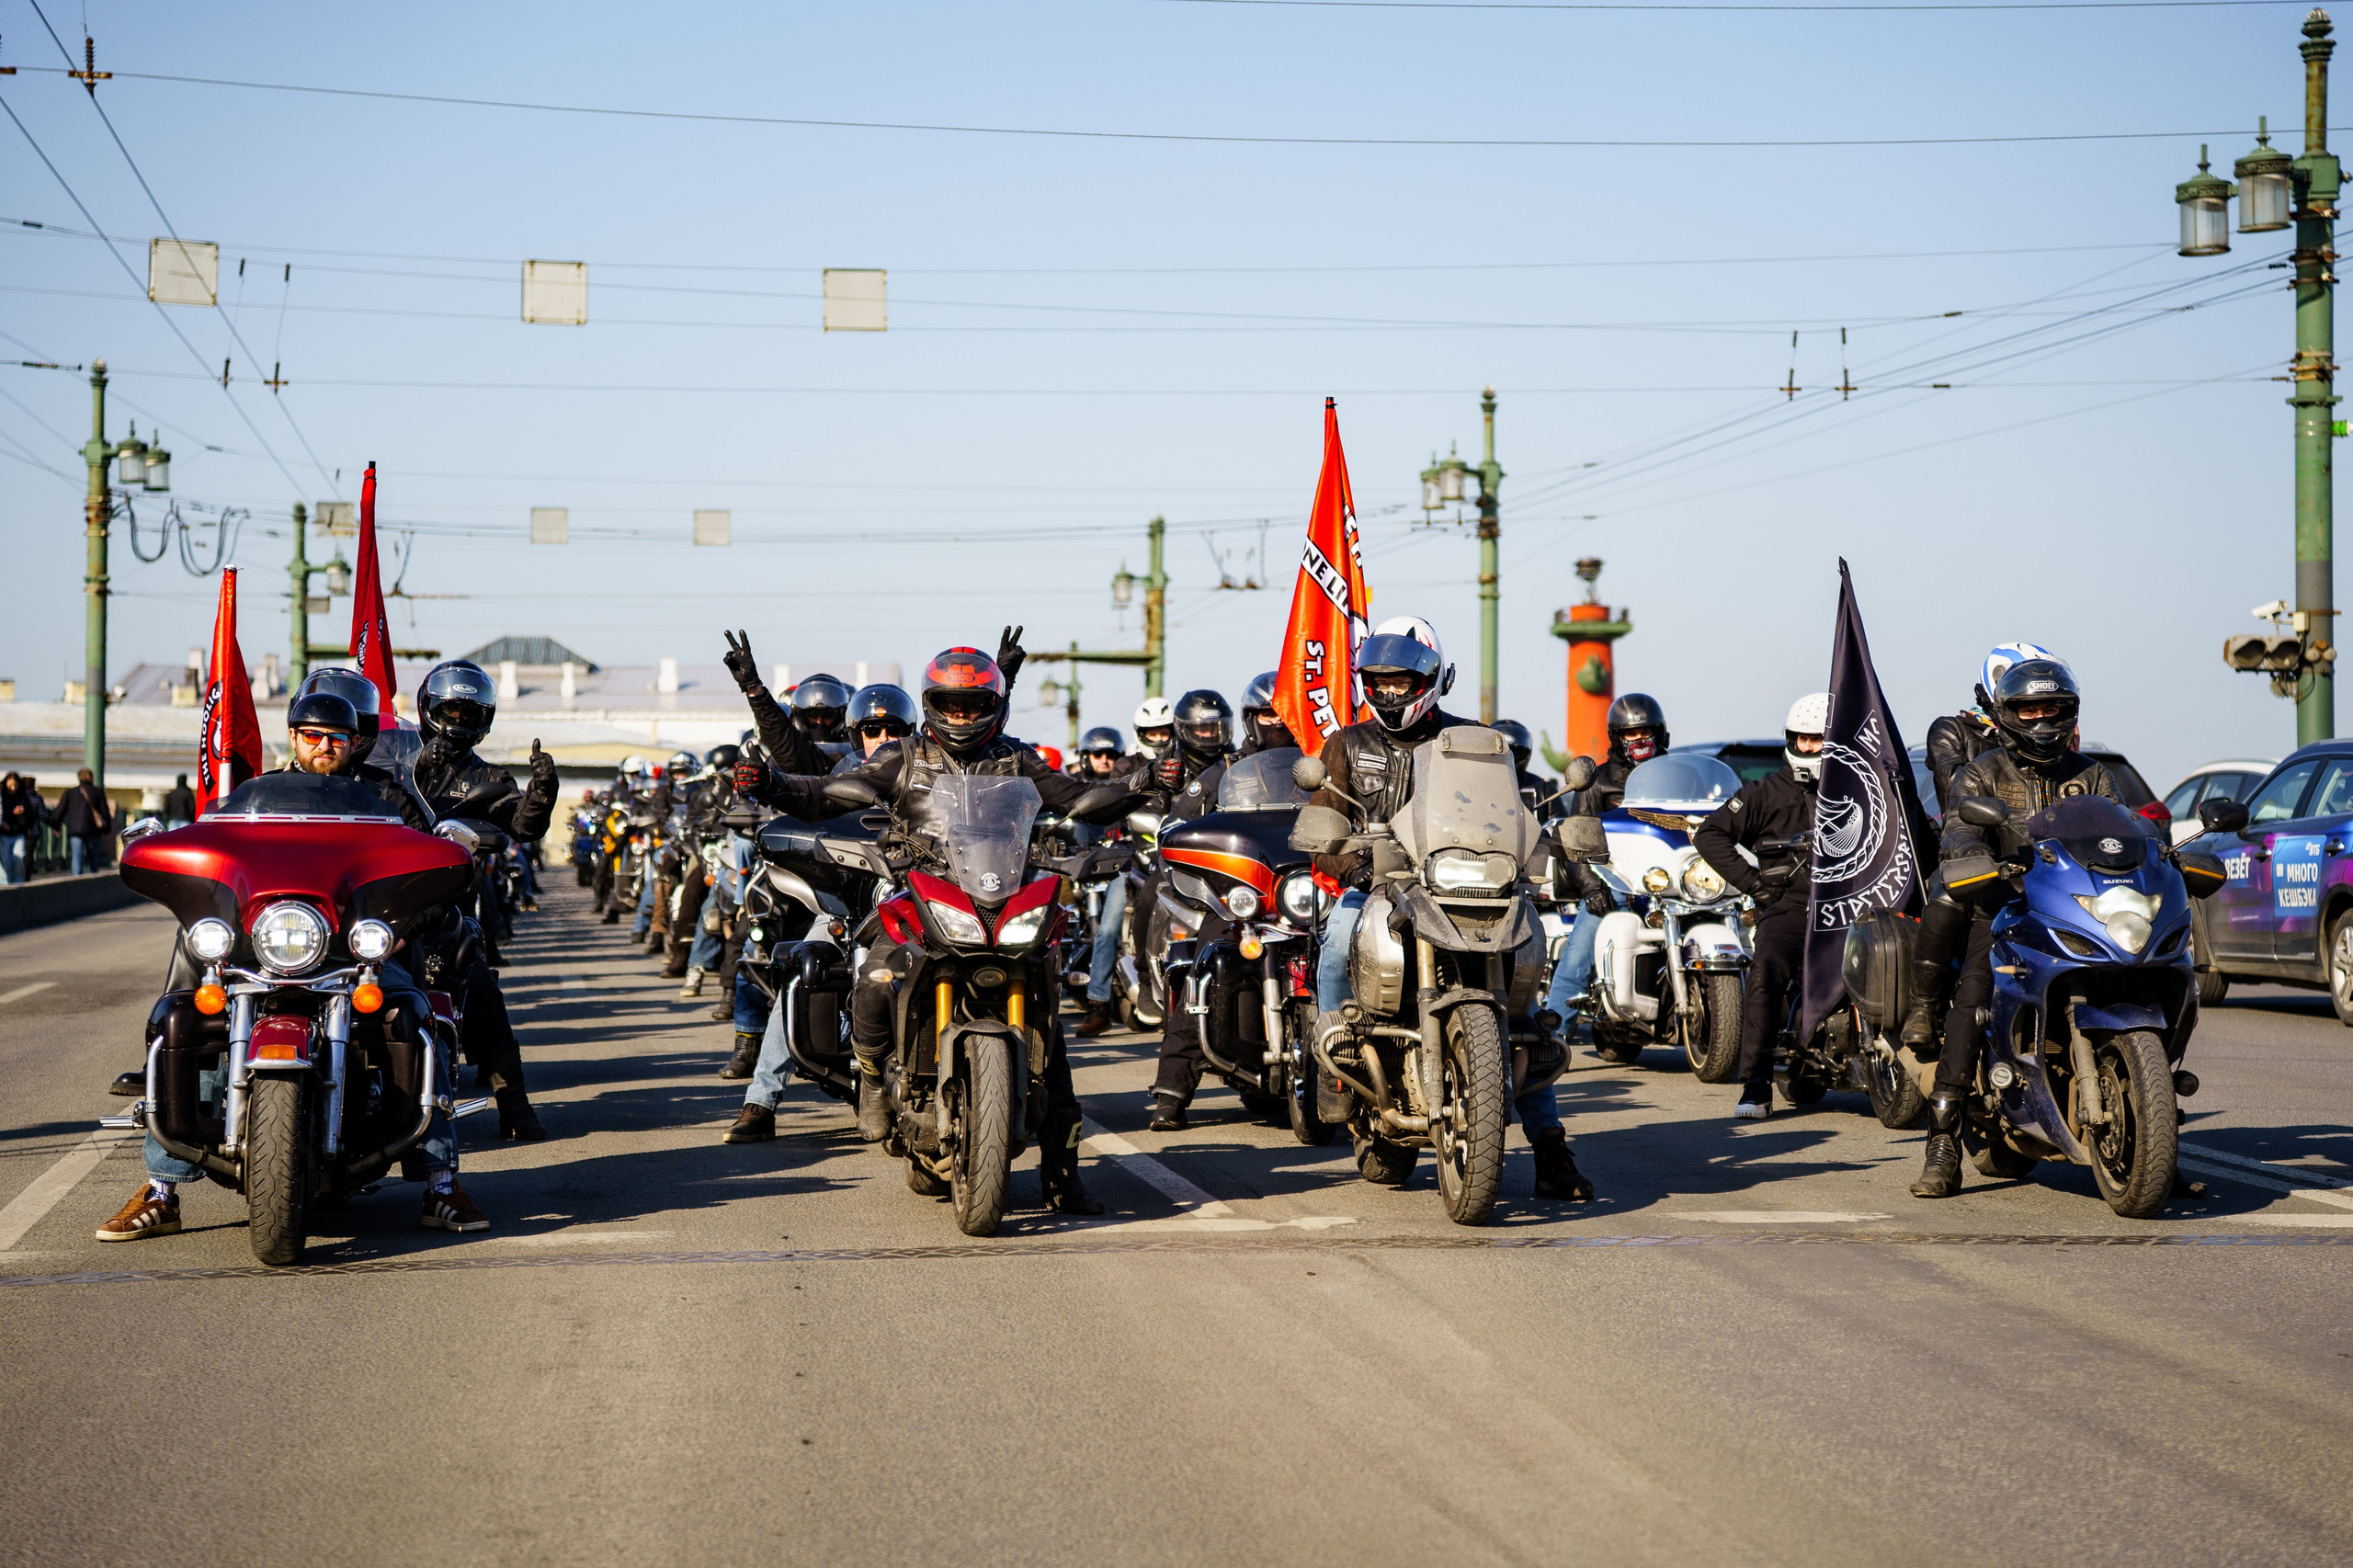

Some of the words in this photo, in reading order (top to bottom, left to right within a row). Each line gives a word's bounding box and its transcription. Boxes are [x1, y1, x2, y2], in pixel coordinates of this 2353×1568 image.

[1302, 542, 1328, 581] NE
[2029, 681, 2056, 690] SHOEI
[201, 687, 222, 748] HOOLIG
[201, 752, 210, 786] THE
[2222, 852, 2251, 880] ВЕЗЁТ
[2287, 862, 2318, 882] МНОГО
[2279, 887, 2316, 907] КЕШБЭКА
